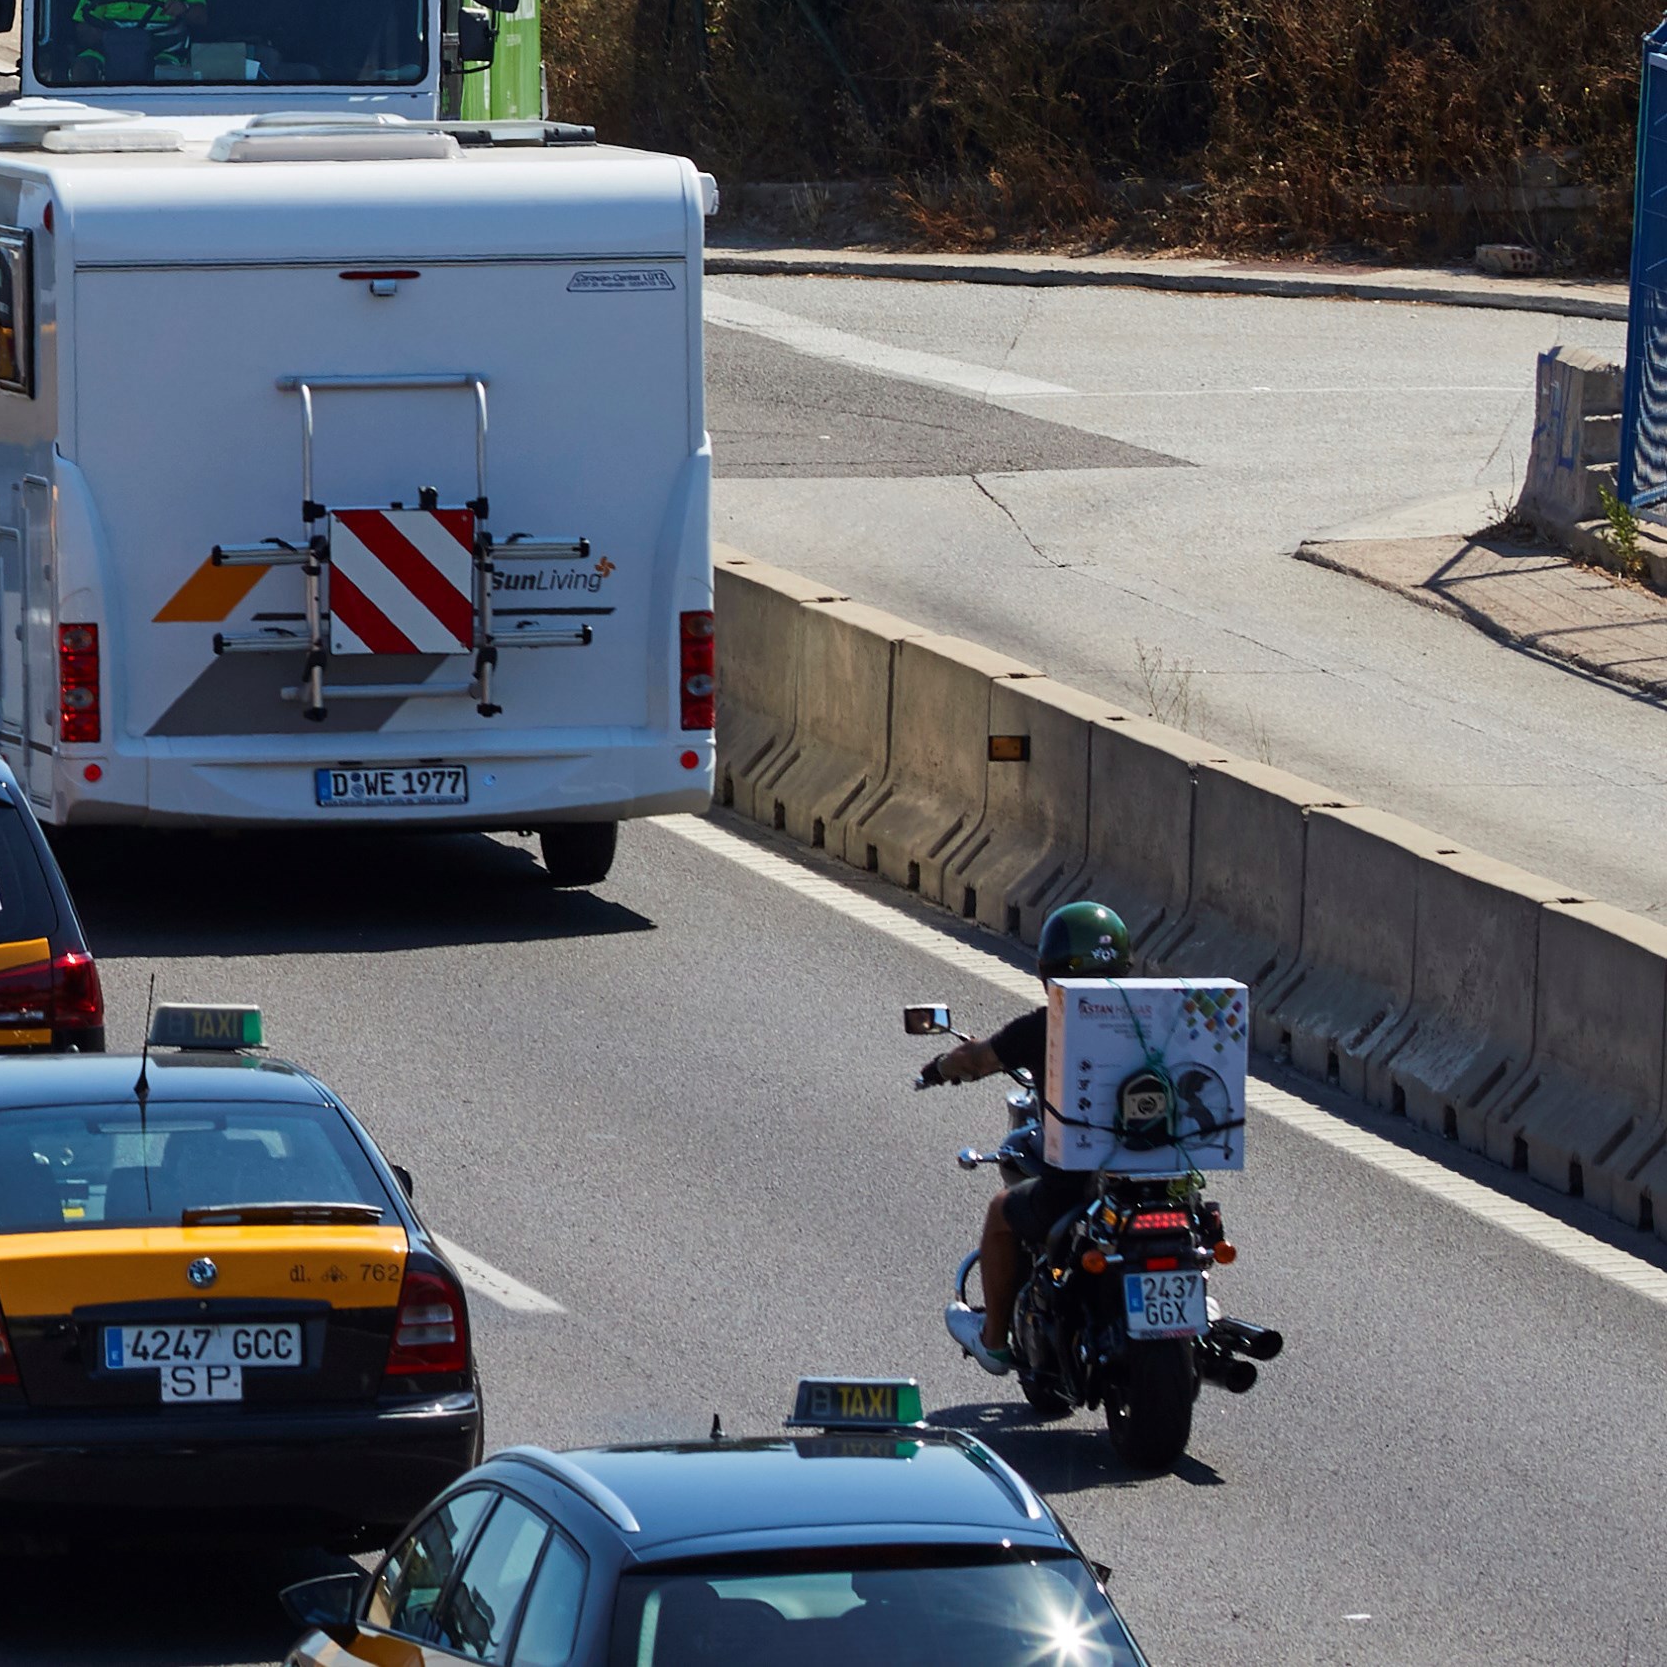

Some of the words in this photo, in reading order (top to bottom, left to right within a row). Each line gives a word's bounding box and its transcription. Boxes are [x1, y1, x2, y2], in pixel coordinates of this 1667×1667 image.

[492, 569, 603, 593] SunLiving
[364, 772, 396, 796] WE
[402, 770, 462, 794] 1977
[192, 1011, 239, 1039] TAXI
[289, 1265, 312, 1283] dl.
[360, 1263, 400, 1283] 762
[1143, 1275, 1198, 1301] 2437
[1145, 1300, 1188, 1326] GGX
[131, 1329, 213, 1361] 4247
[232, 1328, 293, 1360] GCC
[837, 1386, 893, 1418] TAXI
